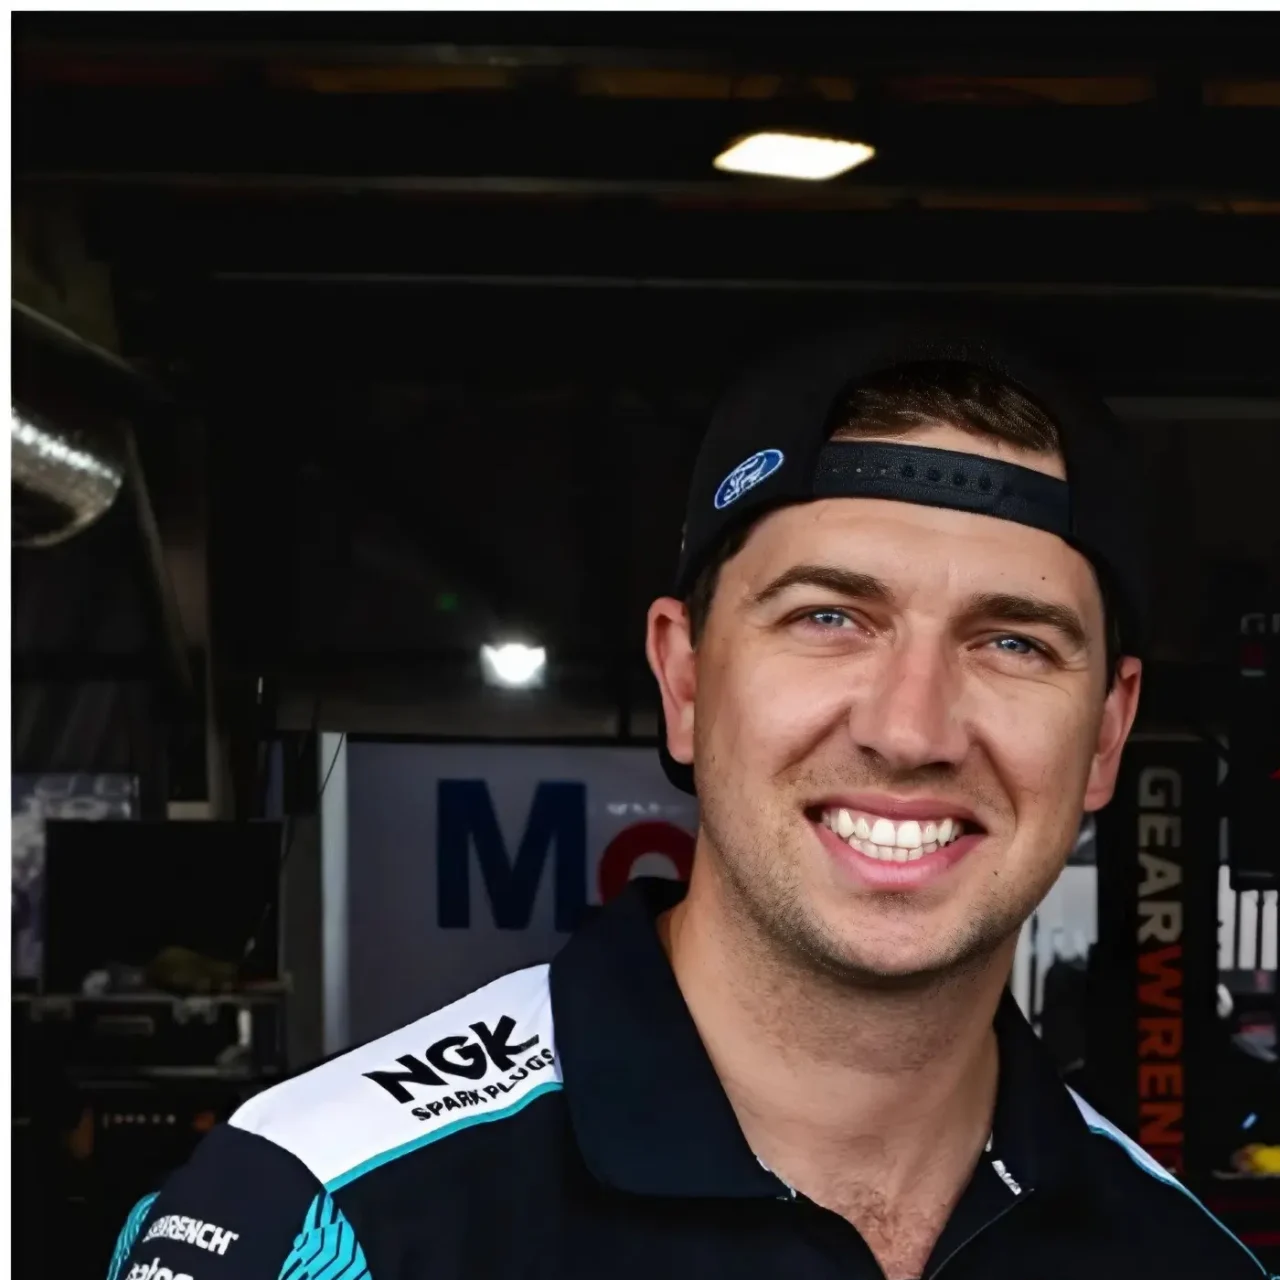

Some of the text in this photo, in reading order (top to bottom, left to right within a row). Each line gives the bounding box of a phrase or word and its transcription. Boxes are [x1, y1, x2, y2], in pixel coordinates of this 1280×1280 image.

[1136, 765, 1185, 1174] GEARWREN
[361, 1014, 540, 1104] NGK
[410, 1047, 556, 1121] SPARK PLUGS
